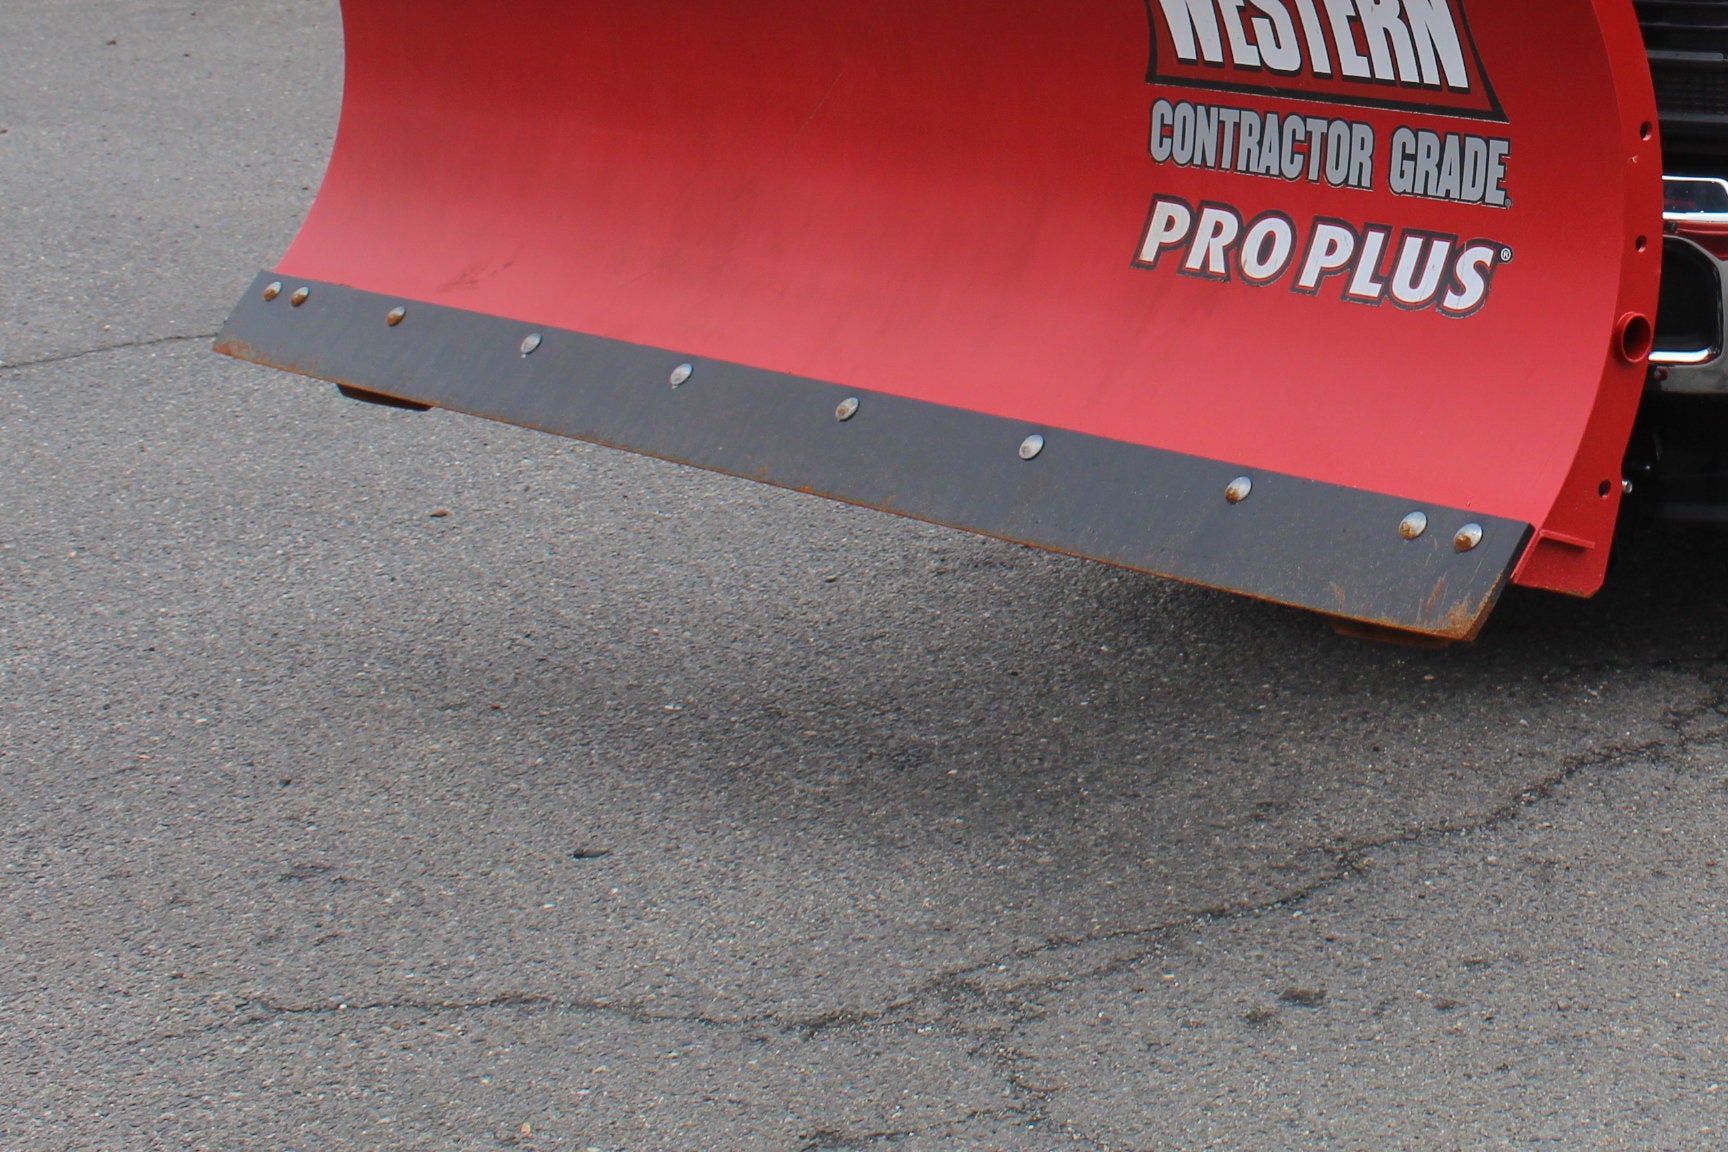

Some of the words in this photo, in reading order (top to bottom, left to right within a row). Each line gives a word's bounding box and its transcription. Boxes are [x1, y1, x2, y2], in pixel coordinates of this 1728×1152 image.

[1149, 99, 1374, 190] CONTRACTOR
[1388, 126, 1510, 207] GRADE
[1137, 199, 1293, 279] PRO
[1297, 222, 1496, 313] PLUS
